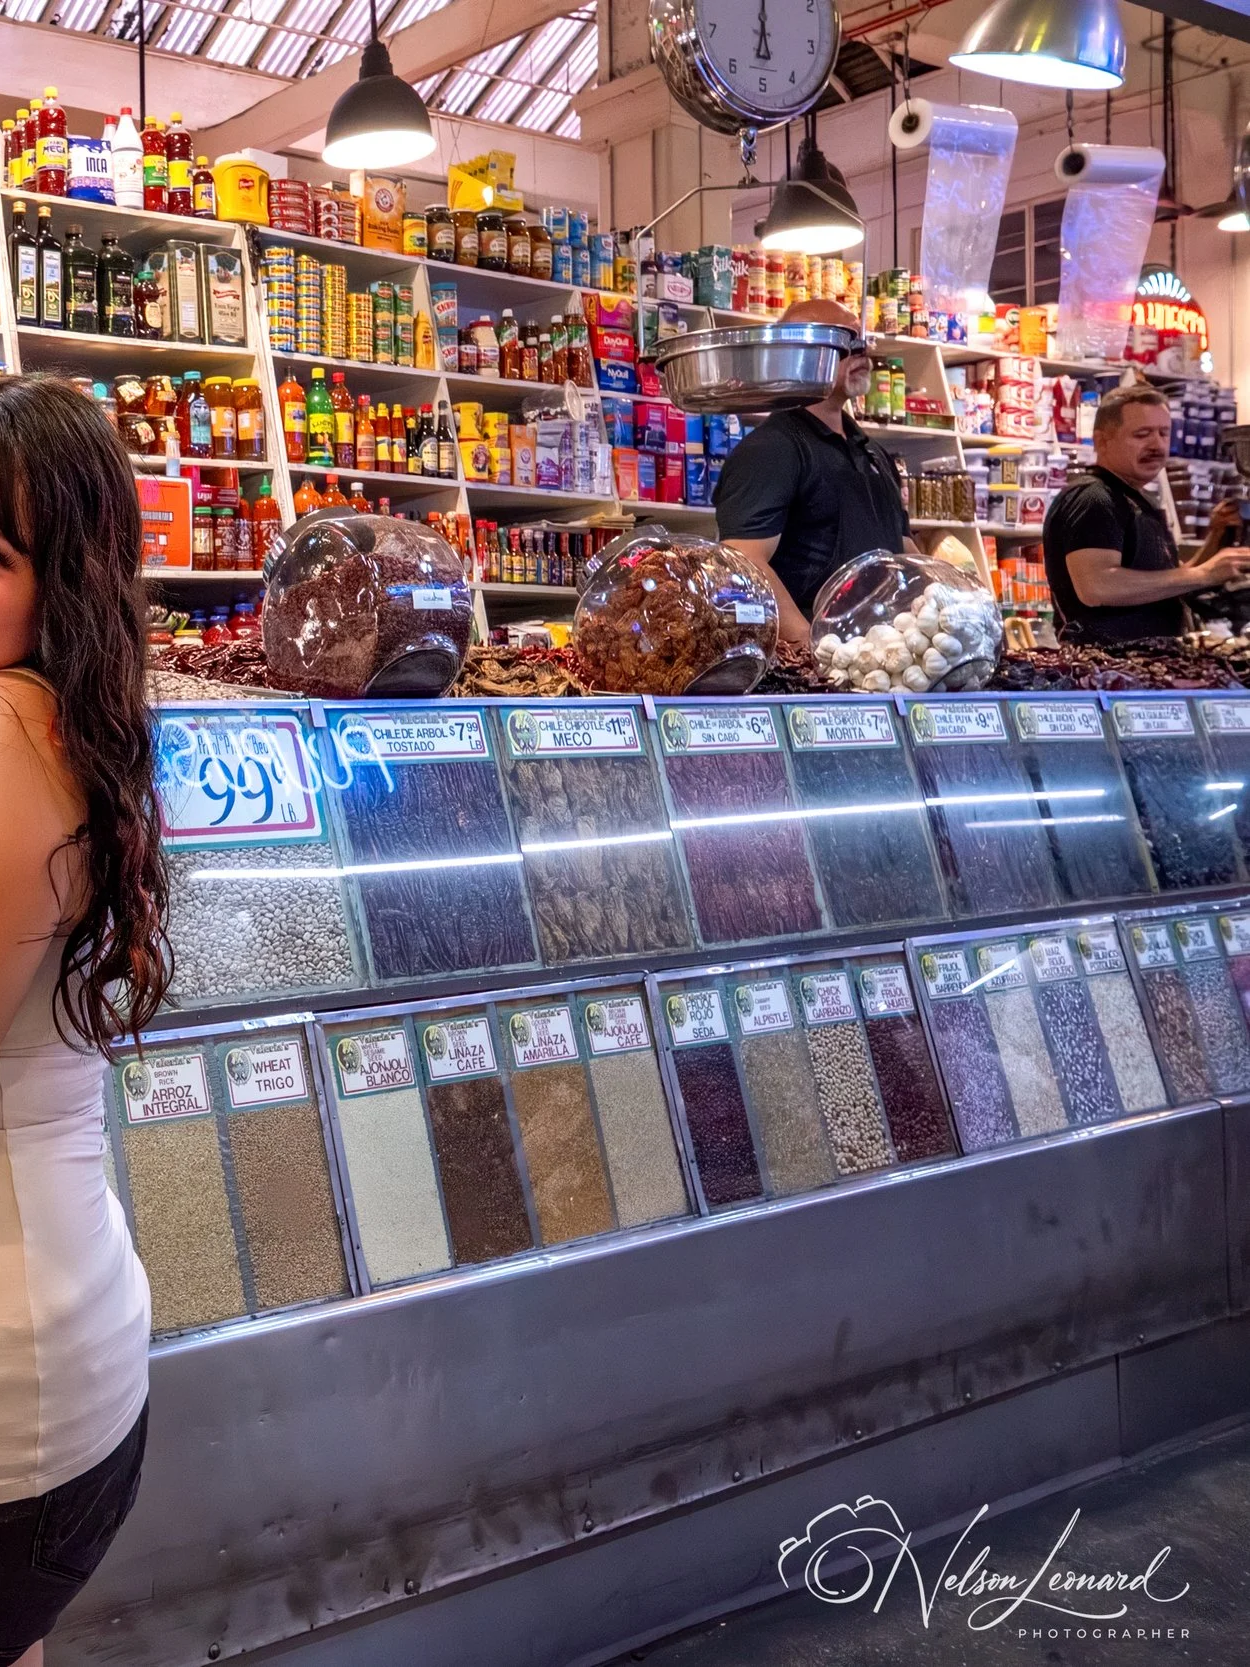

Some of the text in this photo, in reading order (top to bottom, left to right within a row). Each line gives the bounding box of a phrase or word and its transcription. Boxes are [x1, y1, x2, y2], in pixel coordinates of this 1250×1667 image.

[708, 23, 718, 39] 7
[806, 39, 815, 55] 3
[728, 58, 737, 74] 6
[758, 77, 767, 93] 5
[788, 70, 796, 85] 4
[86, 156, 108, 174] INCA
[538, 720, 564, 731] CHILE
[565, 719, 606, 731] CHIPOTLE
[690, 719, 710, 730] CHILE
[373, 728, 402, 740] CHILE
[416, 728, 448, 739] ARBOL
[553, 731, 592, 746] MECO
[701, 732, 740, 743] SIN CABO
[825, 727, 866, 740] MORITA
[386, 741, 435, 752] TOSTADO
[469, 739, 483, 750] LB
[817, 985, 842, 997] CHICK
[820, 996, 842, 1006] PEAS
[604, 1023, 645, 1038] AJONJOLI
[692, 1027, 716, 1039] SEDA
[531, 1034, 567, 1048] LINAZA
[617, 1034, 643, 1048] CAFE
[448, 1045, 486, 1060] LINAZA
[523, 1046, 570, 1061] AMARILLA
[252, 1058, 292, 1074] WHEAT
[360, 1057, 407, 1076] AJONJOLI
[456, 1057, 486, 1071] CAFE
[154, 1069, 179, 1079] BROWN
[366, 1069, 410, 1087] BLANCO
[158, 1078, 175, 1086] RICE
[255, 1075, 295, 1092] TRIGO
[151, 1085, 193, 1102] ARROZ
[142, 1097, 203, 1117] INTEGRAL
